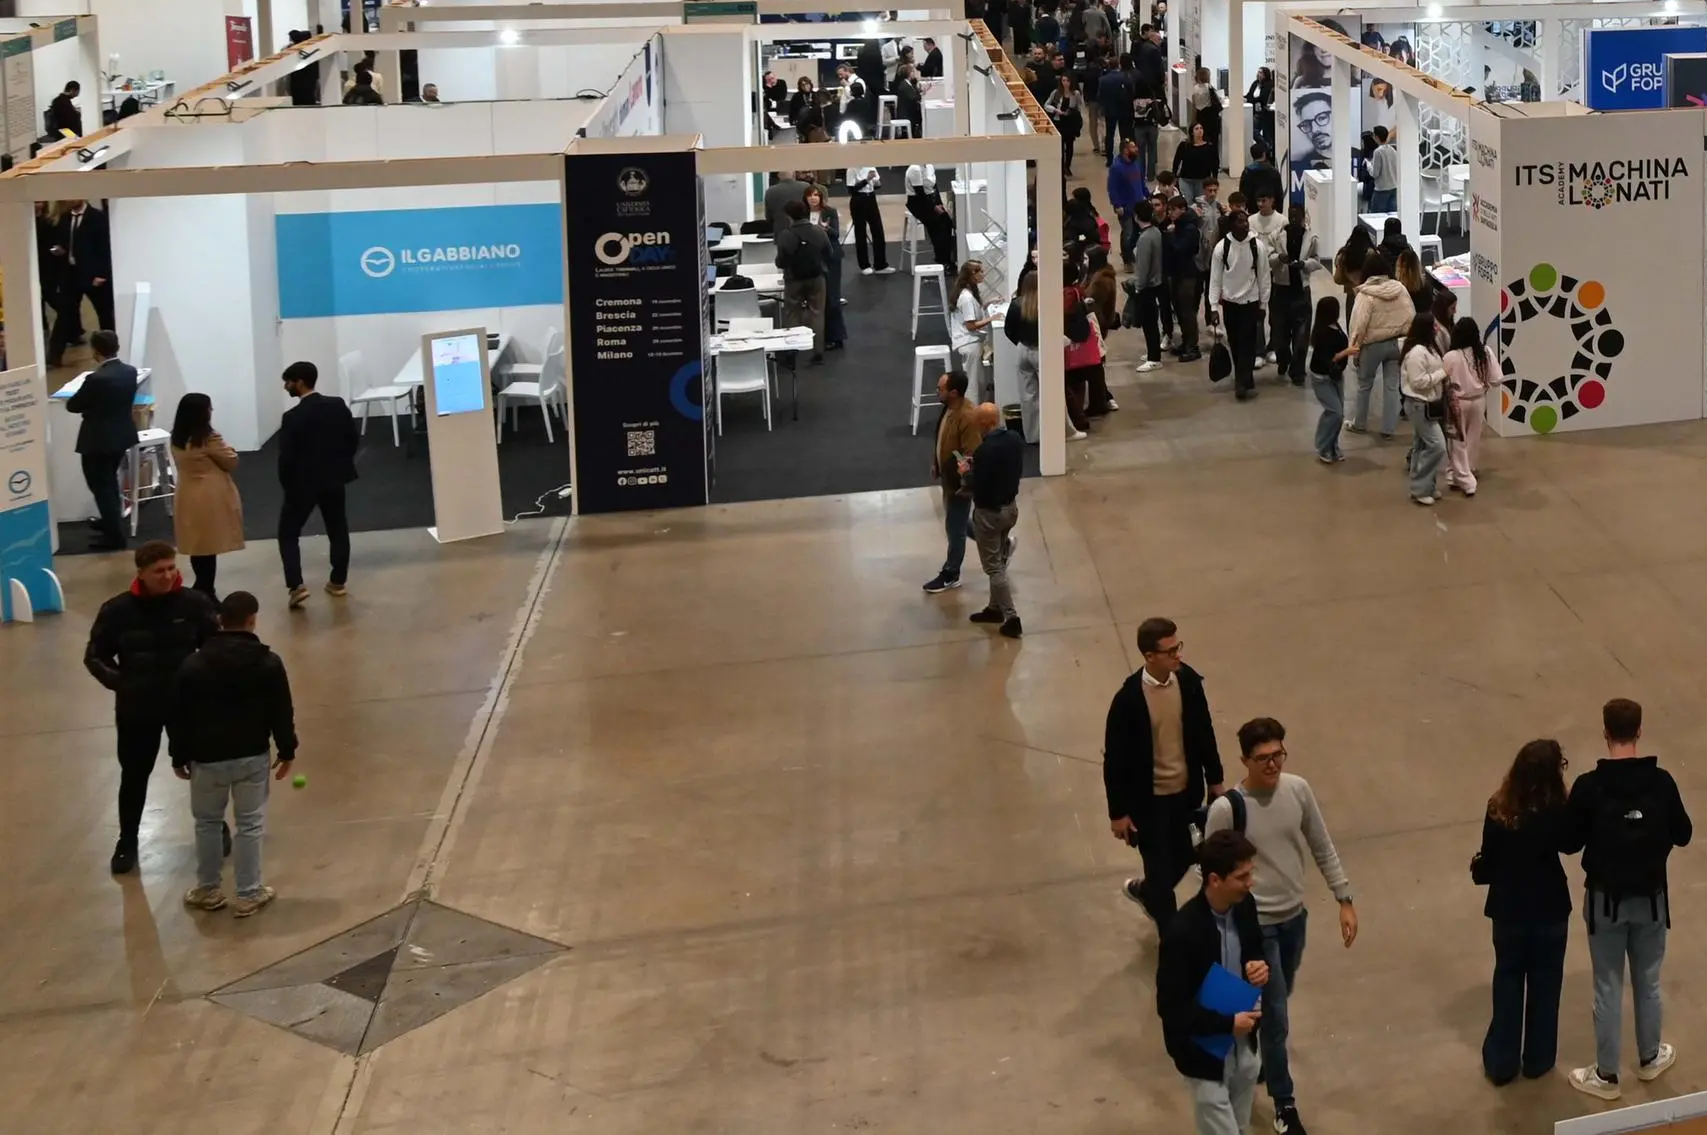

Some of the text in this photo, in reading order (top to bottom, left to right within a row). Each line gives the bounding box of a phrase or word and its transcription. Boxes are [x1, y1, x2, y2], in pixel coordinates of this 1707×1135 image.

[1515, 164, 1555, 186] ITS
[1569, 157, 1689, 183] MACHINA
[595, 231, 671, 265] Open
[595, 298, 642, 306] Cremona
[595, 311, 637, 320] Brescia
[596, 325, 643, 333] Piacenza
[596, 338, 627, 346] Roma
[597, 351, 634, 360] Milano
